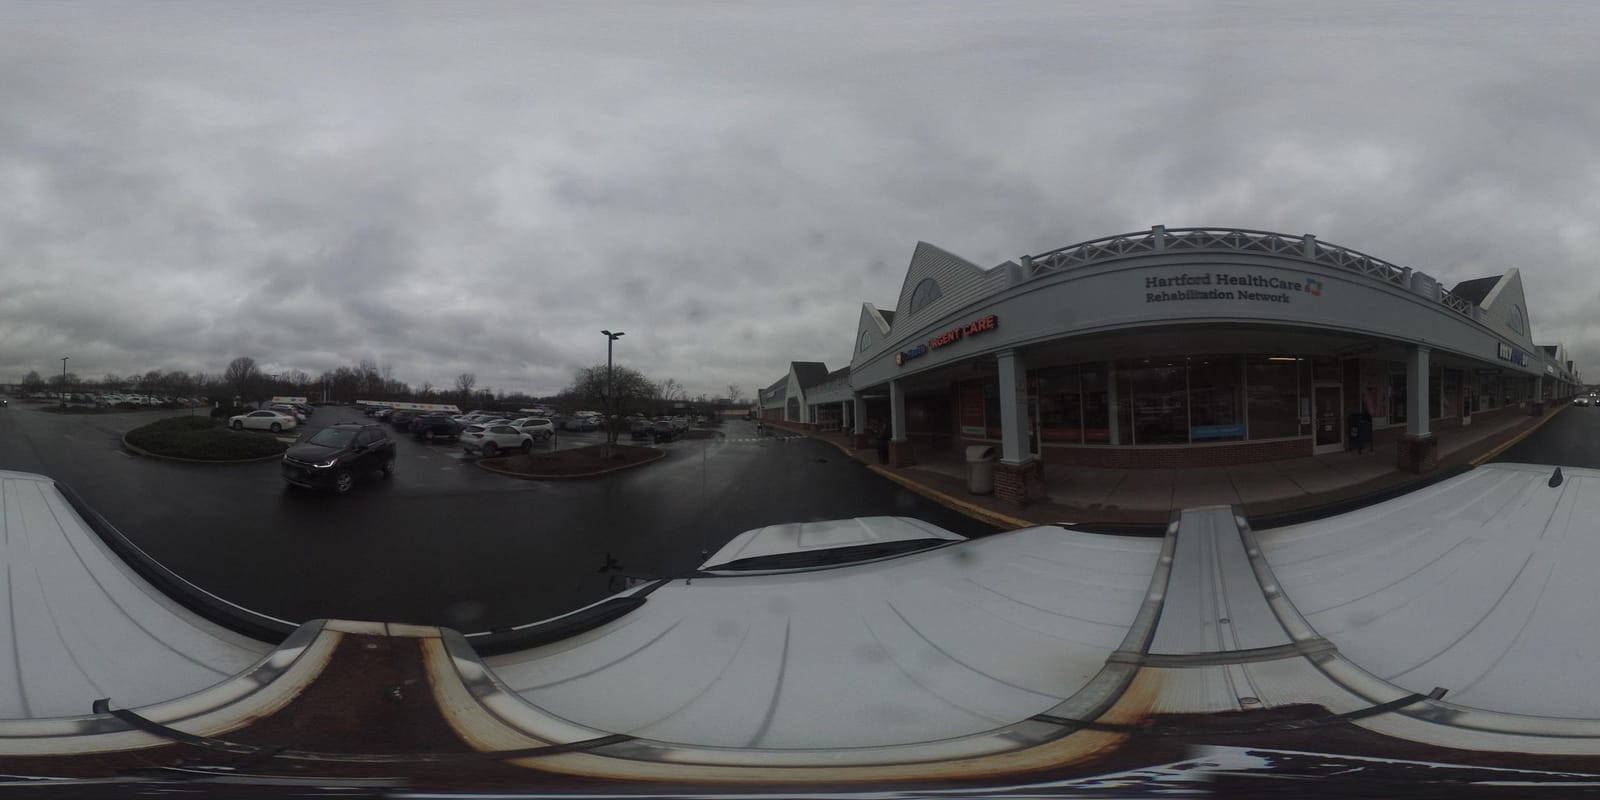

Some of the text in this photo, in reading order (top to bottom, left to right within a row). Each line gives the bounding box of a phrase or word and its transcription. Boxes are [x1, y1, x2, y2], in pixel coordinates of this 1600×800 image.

[1145, 273, 1302, 291] Hartford HealthCare
[1238, 290, 1290, 303] Network
[927, 314, 997, 350] URGENT CARE
